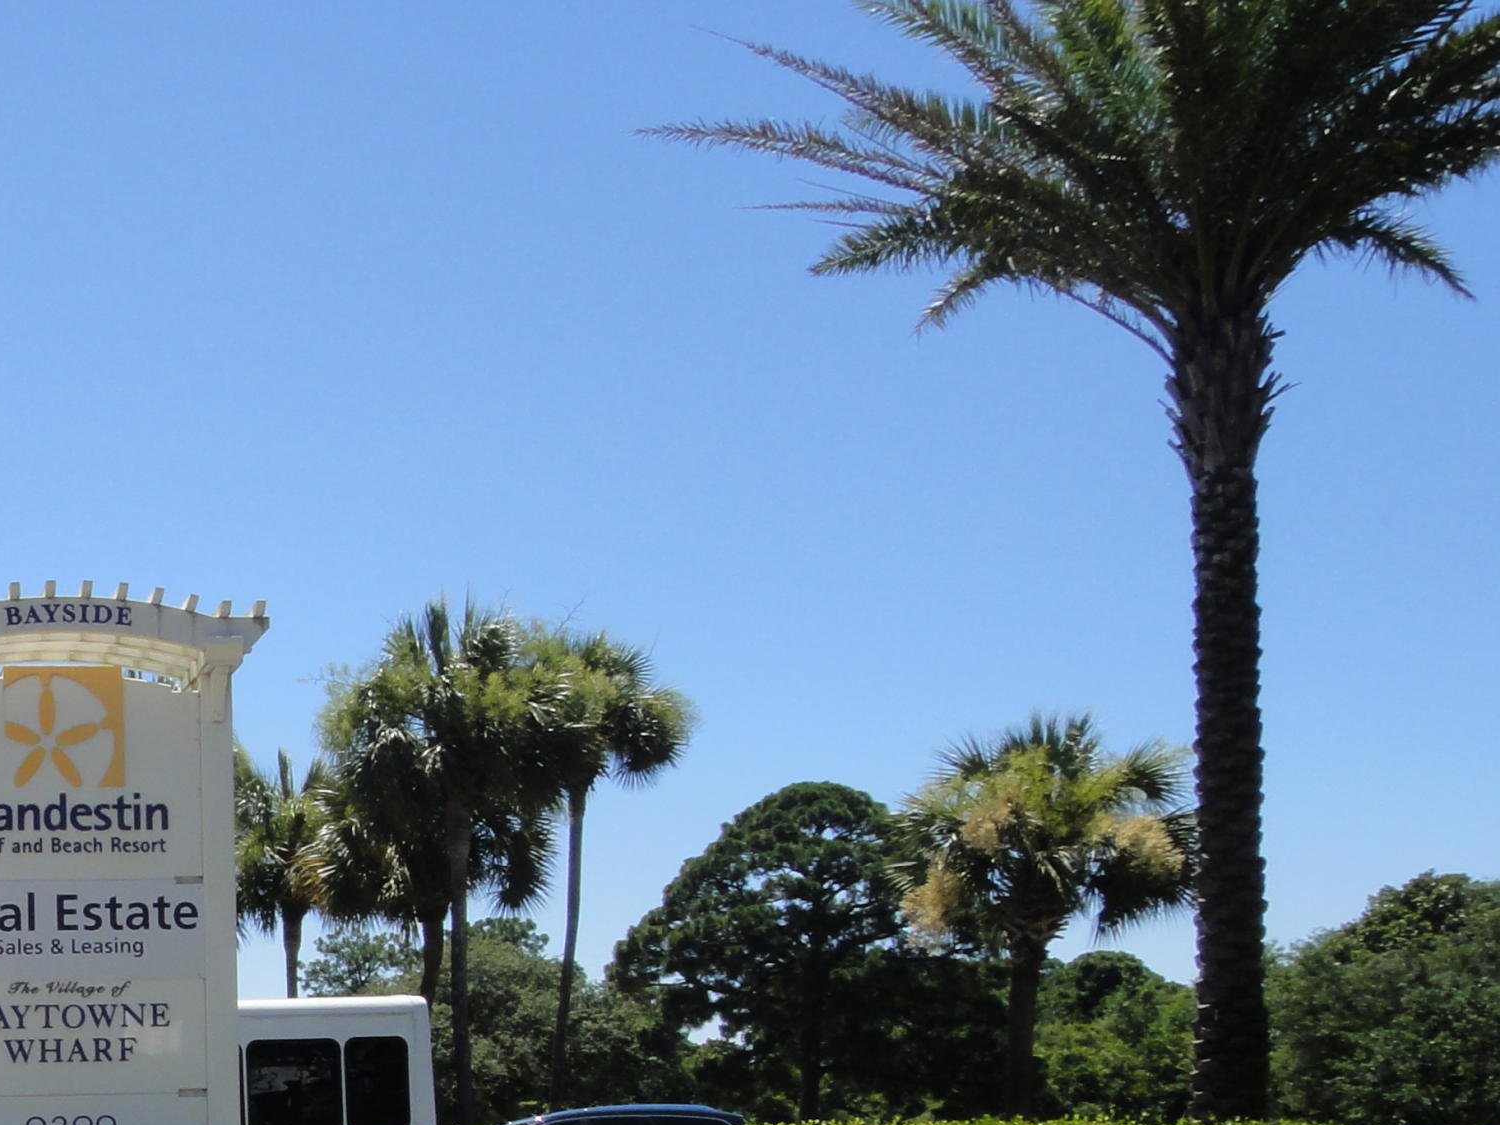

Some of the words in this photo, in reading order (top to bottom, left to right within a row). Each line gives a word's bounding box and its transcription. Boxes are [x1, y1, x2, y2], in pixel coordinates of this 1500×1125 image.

[5, 603, 133, 627] BAYSIDE
[11, 837, 43, 854] and
[50, 836, 103, 854] Beach
[110, 836, 167, 854] Resort
[56, 894, 199, 931] Estate
[50, 938, 64, 955] &
[71, 937, 145, 958] Leasing
[7, 981, 39, 995] The
[45, 981, 106, 999] Village
[110, 980, 132, 999] of
[3, 1037, 138, 1063] WHARF
